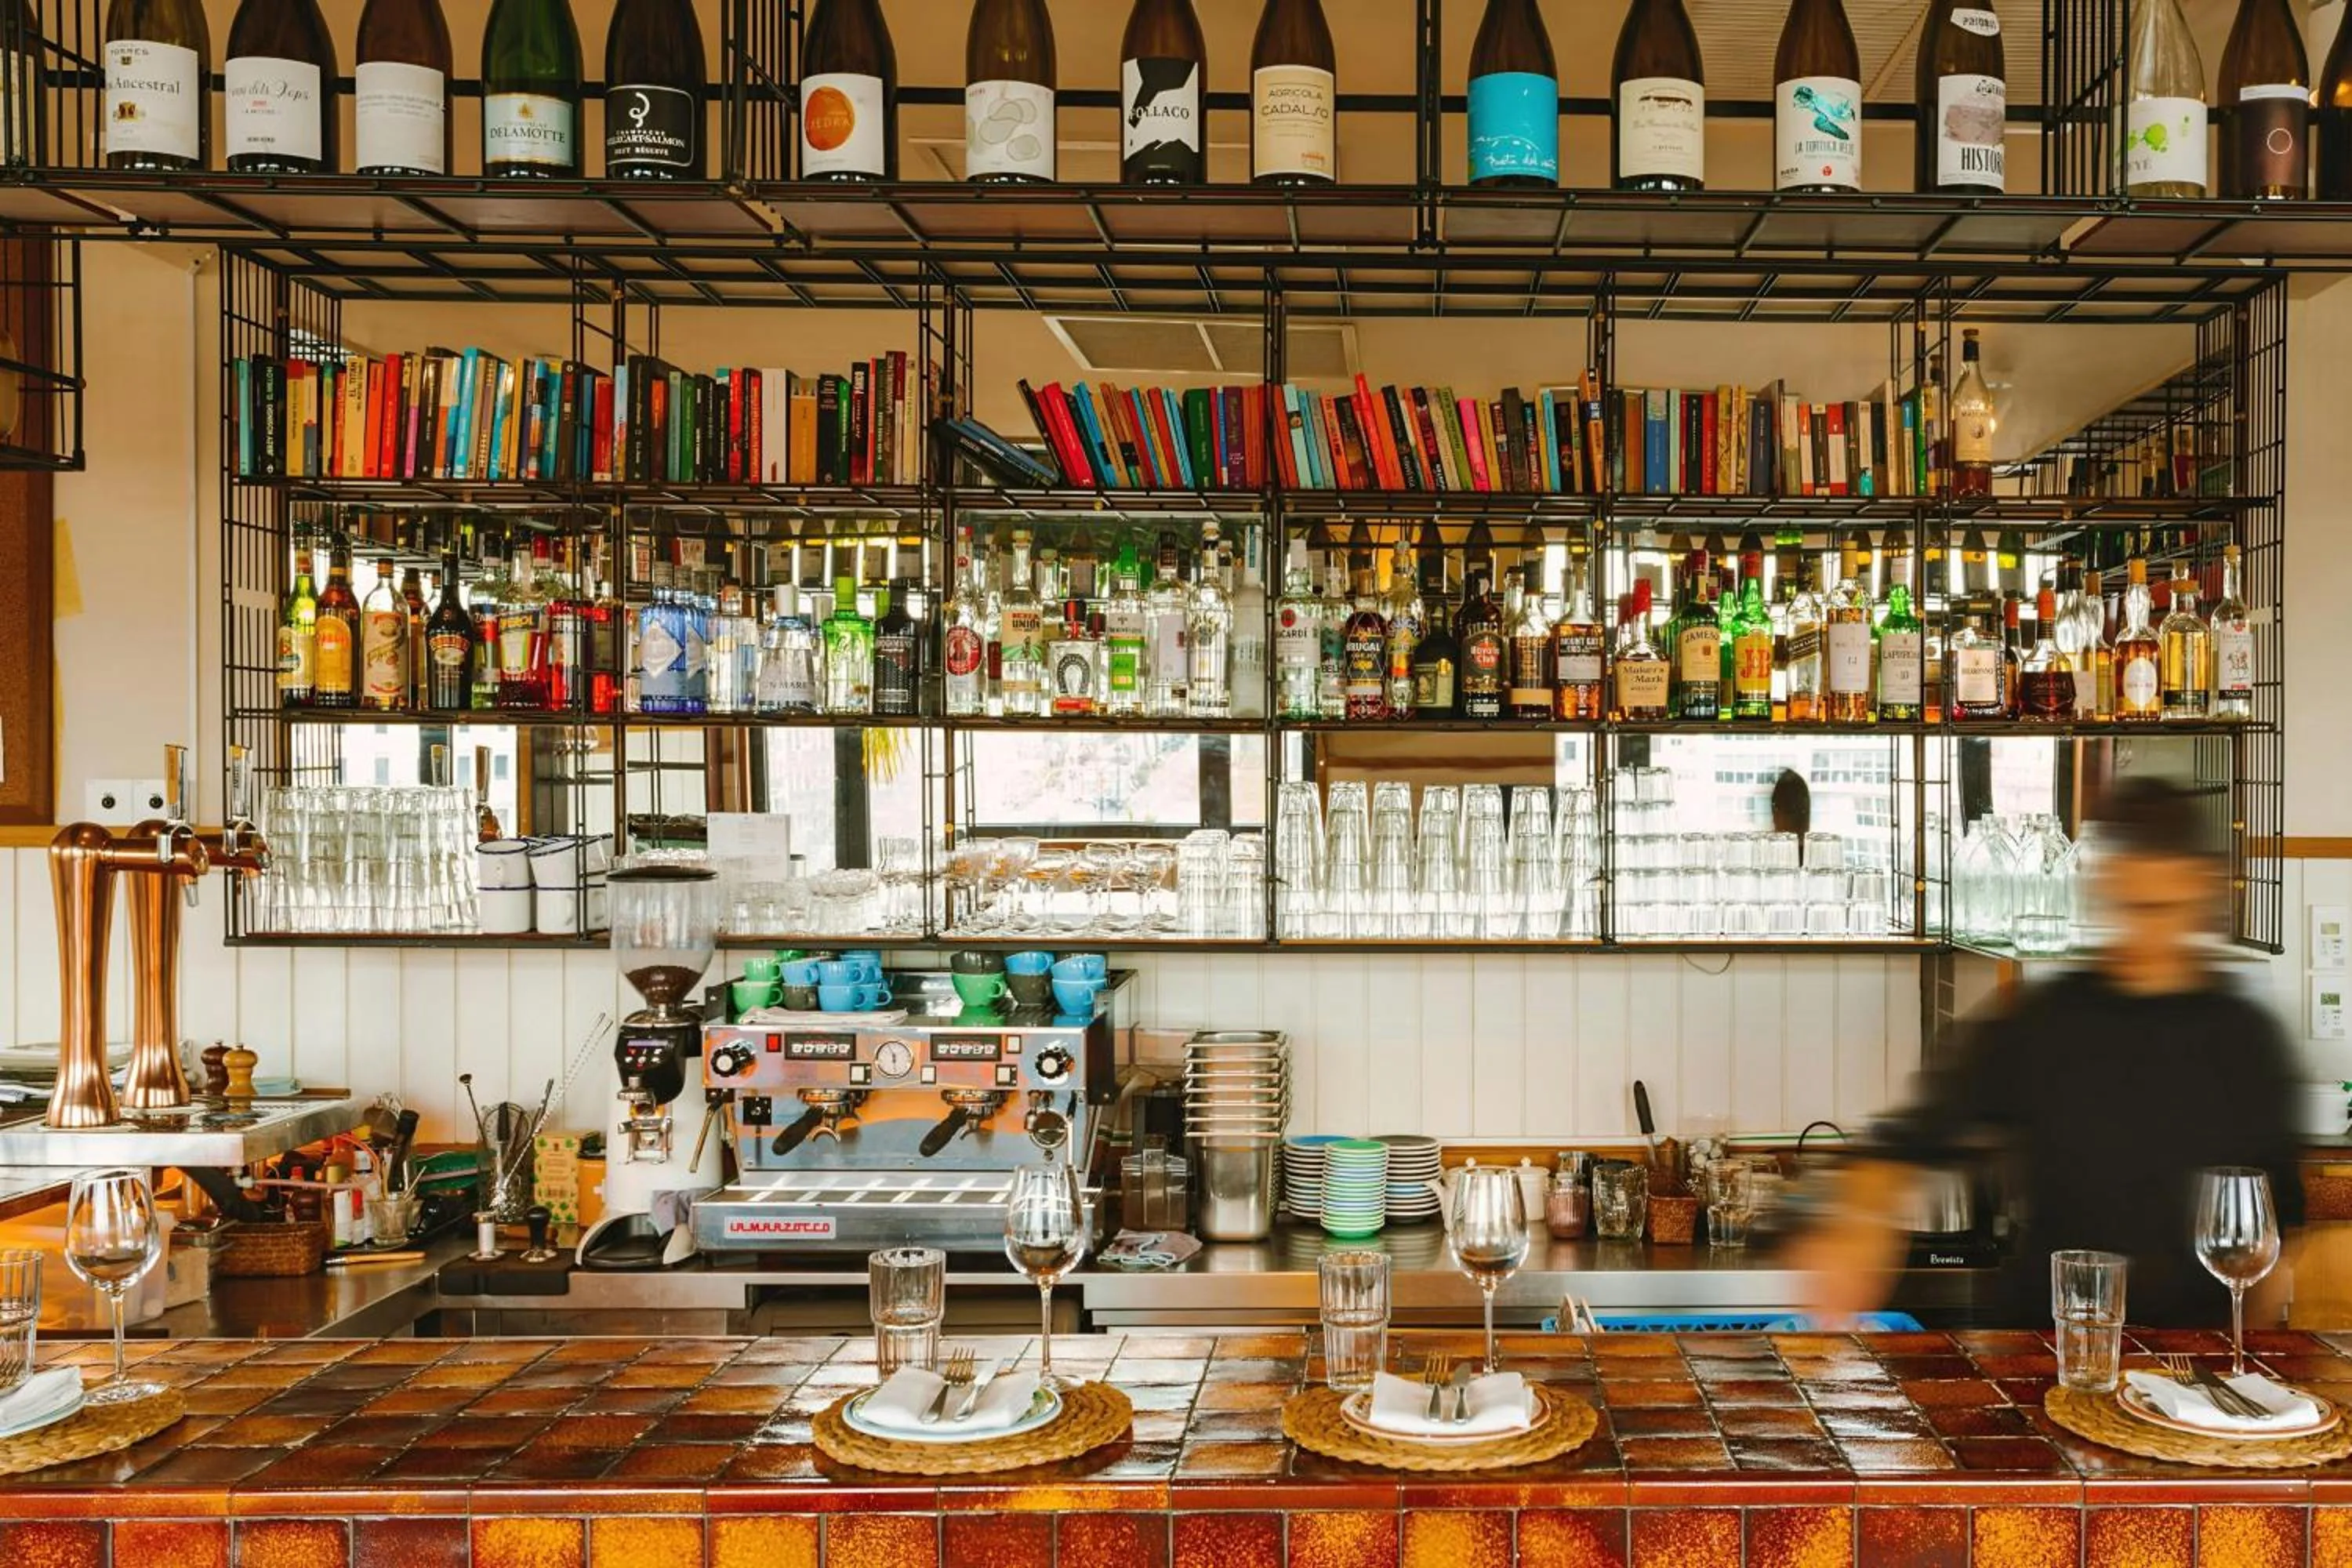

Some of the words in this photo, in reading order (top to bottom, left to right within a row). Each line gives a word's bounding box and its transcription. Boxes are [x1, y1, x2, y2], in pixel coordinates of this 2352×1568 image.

[490, 126, 565, 143] DELAMOTTE
[1346, 642, 1381, 652] BRUGAL
[1624, 666, 1664, 675] Maker's
[1635, 675, 1664, 684] Mark
